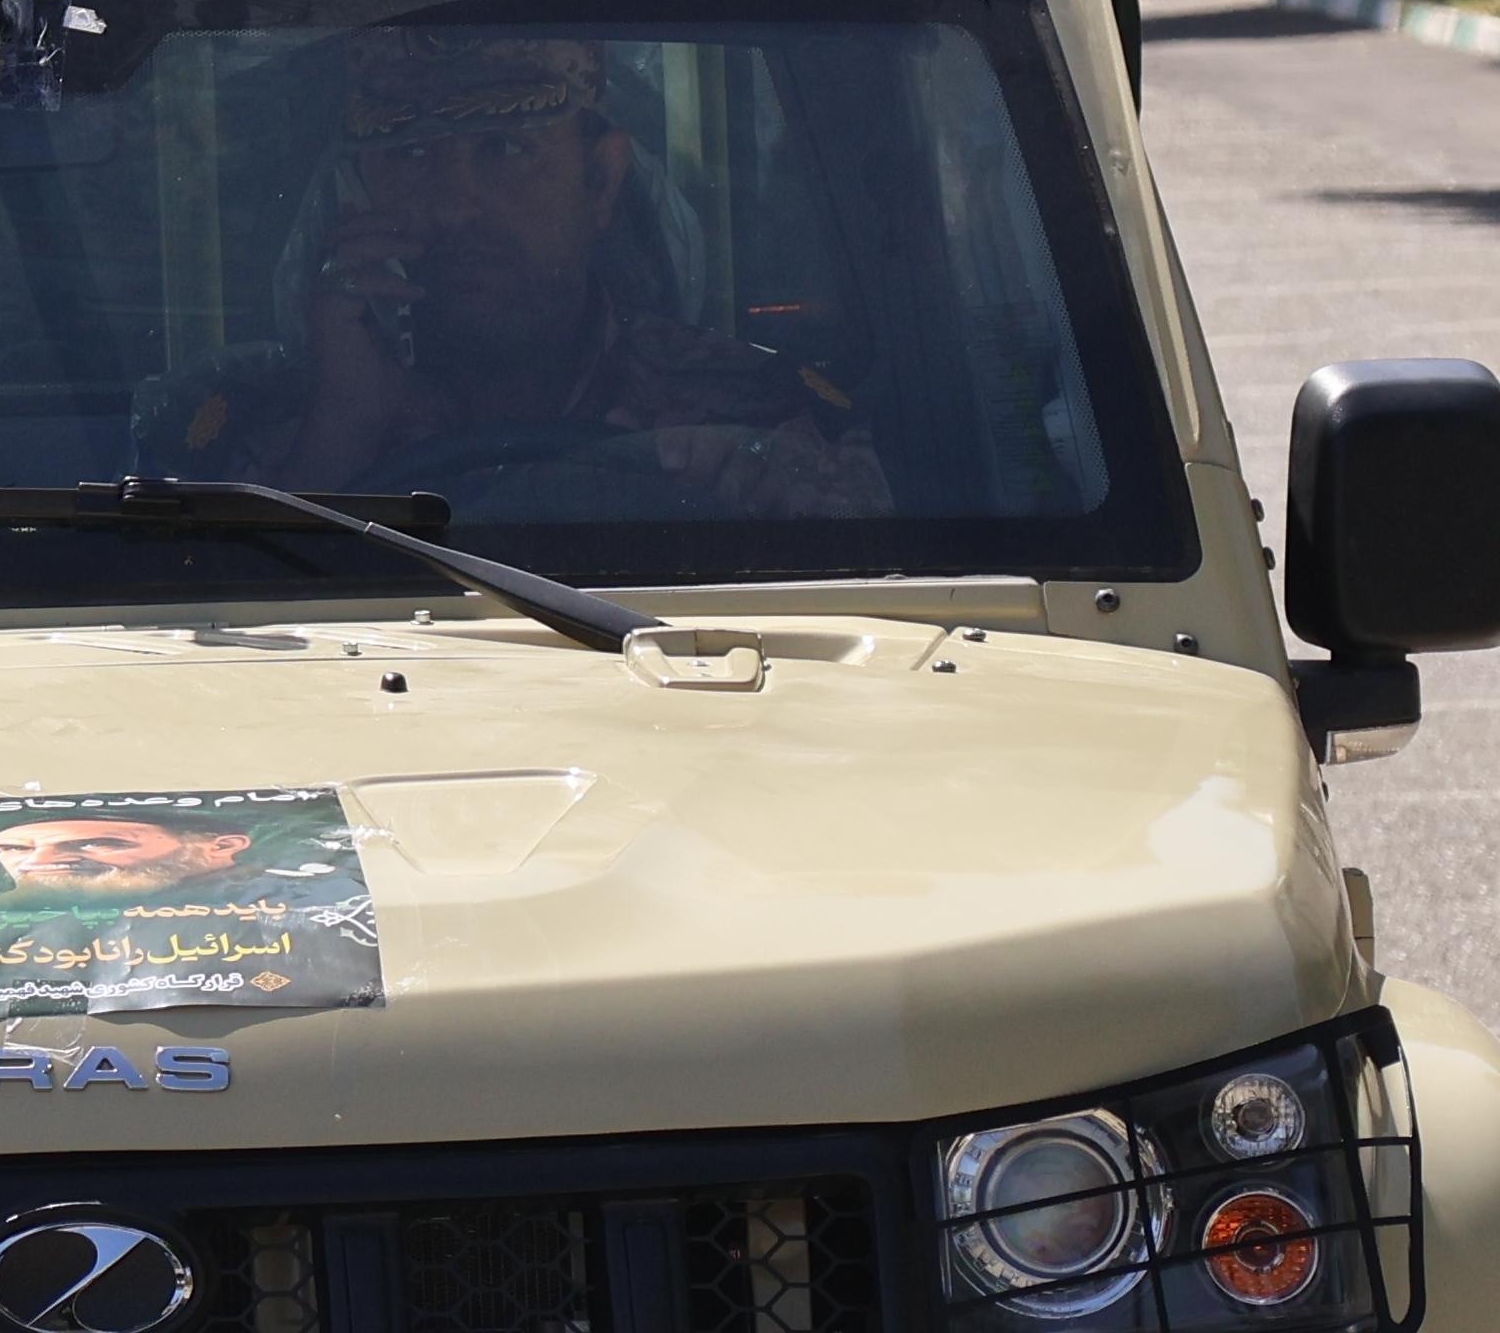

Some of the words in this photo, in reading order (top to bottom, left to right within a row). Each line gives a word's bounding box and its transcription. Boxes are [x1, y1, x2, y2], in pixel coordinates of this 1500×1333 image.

[123, 902, 210, 919] همه
[212, 899, 288, 919] باید
[32, 937, 120, 970] نابود
[121, 937, 145, 966] را
[146, 932, 292, 965] اسرائیل
[38, 980, 84, 999] شهید
[87, 976, 157, 999] کشوری
[157, 972, 245, 993] قرارگاه
